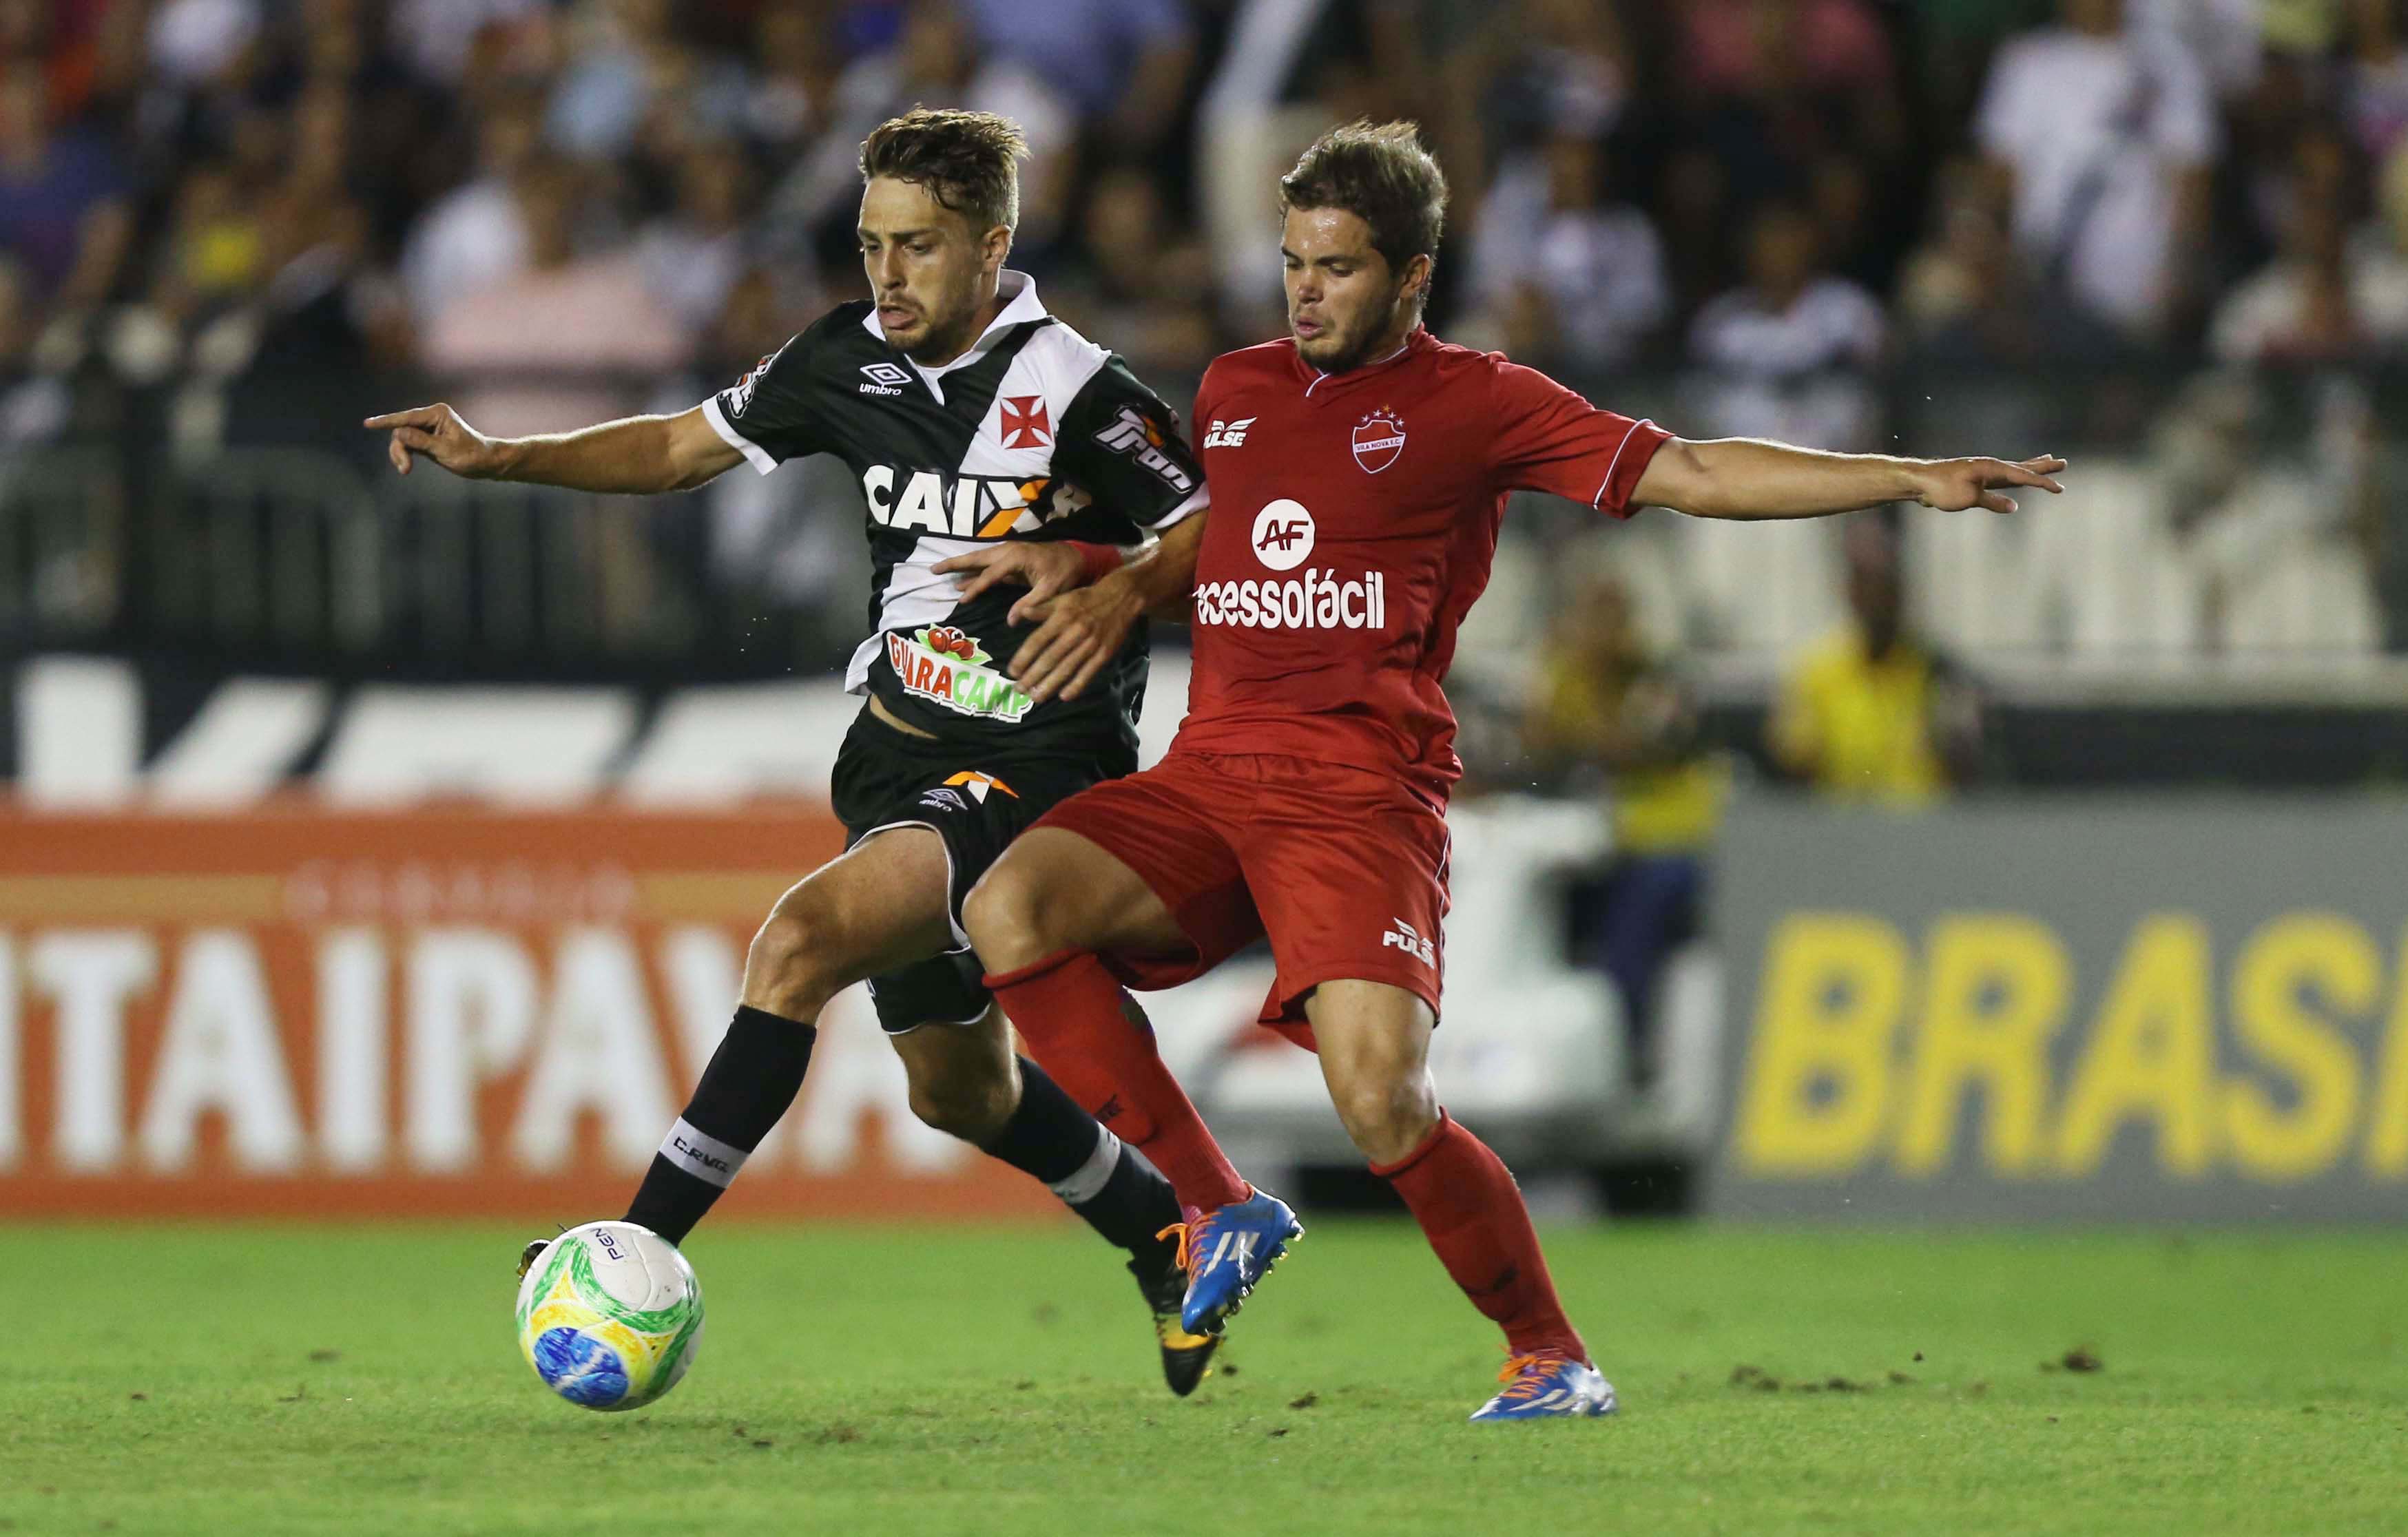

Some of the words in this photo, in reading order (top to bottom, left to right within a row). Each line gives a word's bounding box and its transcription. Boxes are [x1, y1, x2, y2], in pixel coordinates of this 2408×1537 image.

[859, 383, 902, 396] umbro
[1203, 430, 1247, 450] ULSE
[1371, 440, 1389, 448] NOVA
[1256, 519, 1309, 551] AF
[890, 634, 1032, 716] GUARACAMP
[1382, 930, 1435, 970] PULS
